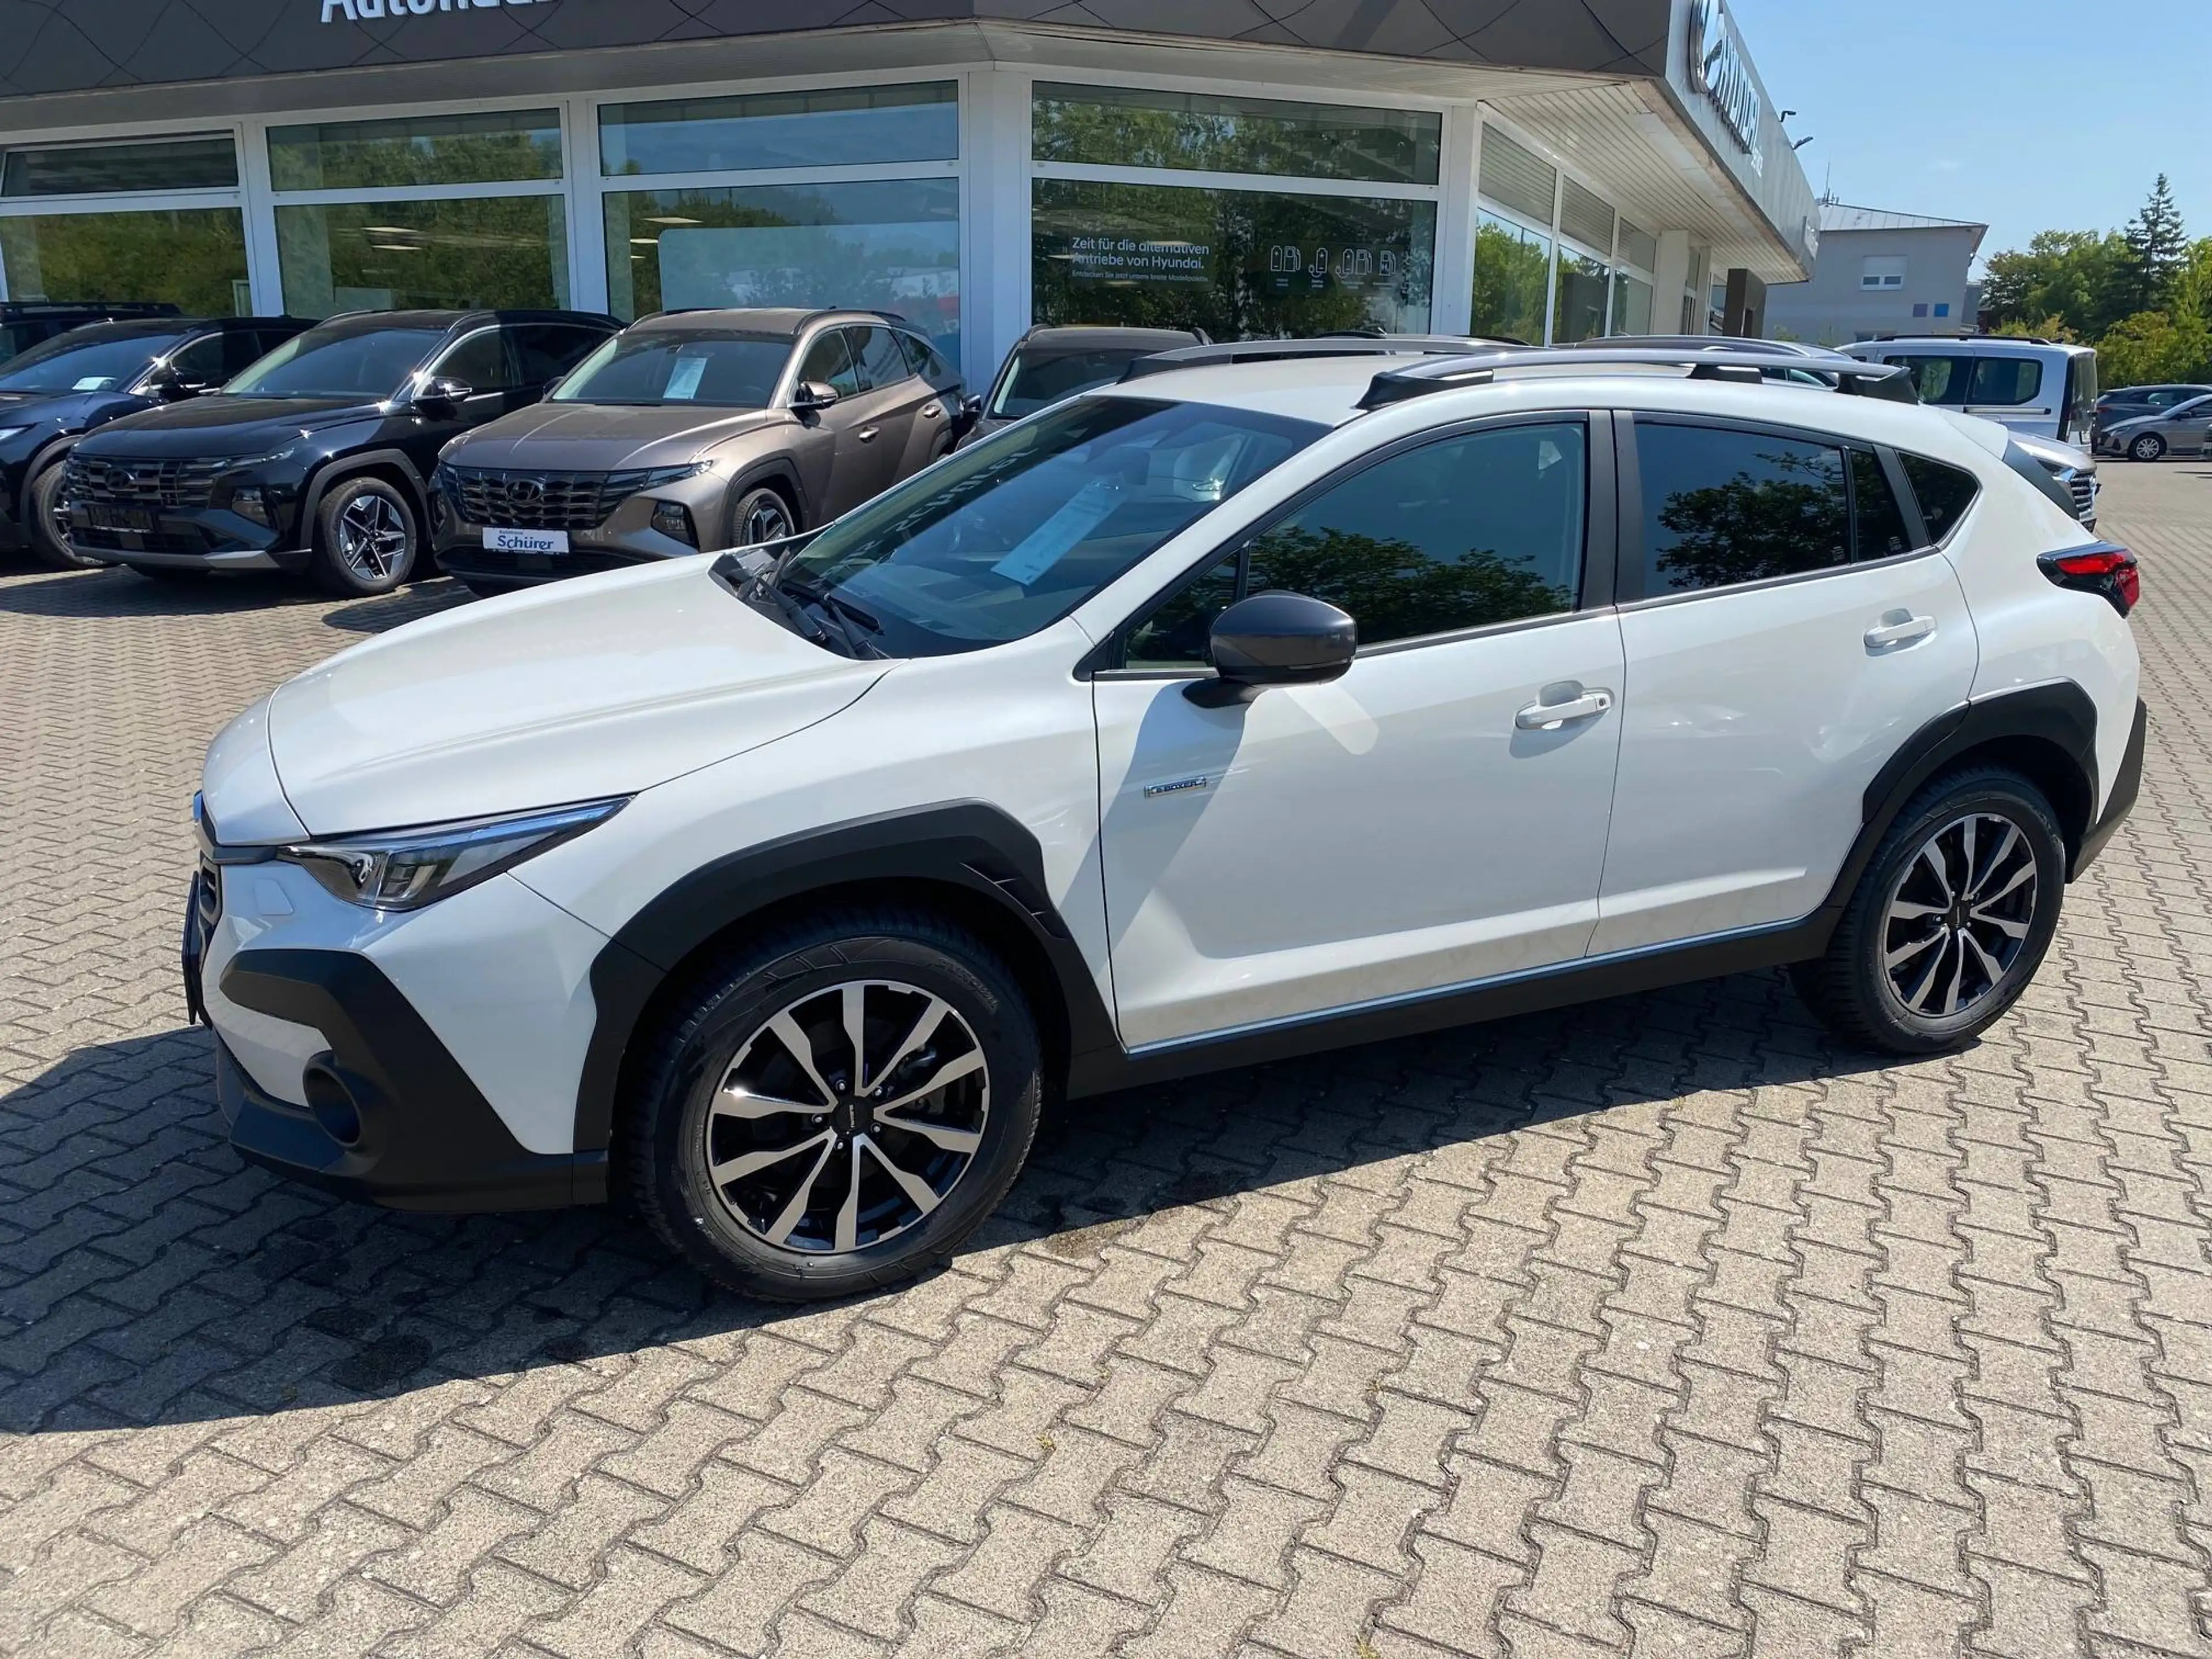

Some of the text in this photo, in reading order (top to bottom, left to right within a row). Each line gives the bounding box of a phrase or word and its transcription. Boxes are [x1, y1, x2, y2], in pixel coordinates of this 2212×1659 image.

[1073, 237, 1209, 255] Zeit für die alternativen
[1072, 252, 1204, 270] Antriebe von Hyundai.
[498, 535, 554, 550] Schürer
